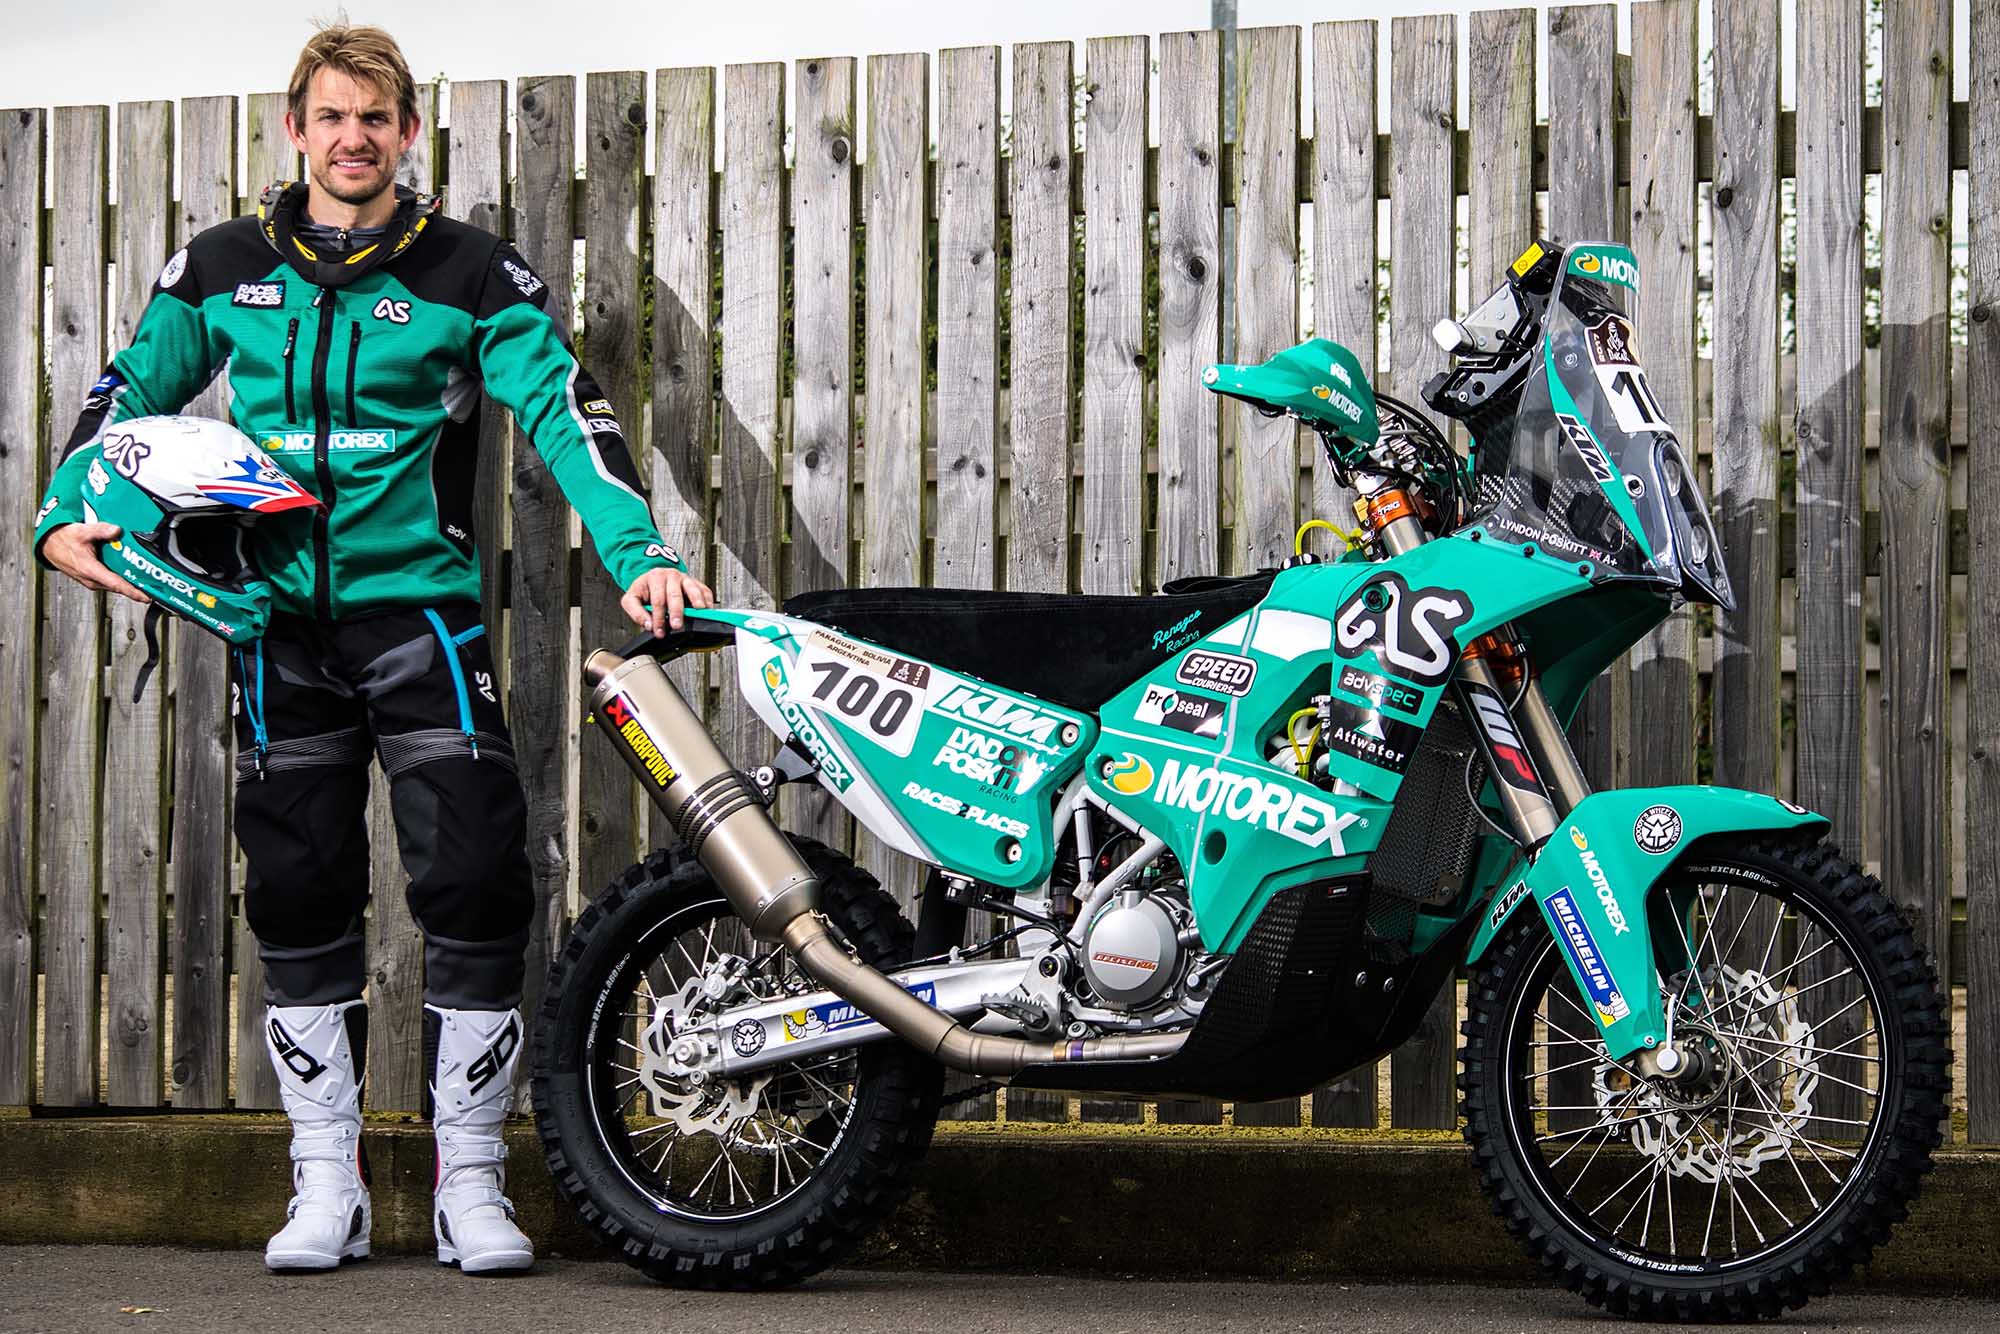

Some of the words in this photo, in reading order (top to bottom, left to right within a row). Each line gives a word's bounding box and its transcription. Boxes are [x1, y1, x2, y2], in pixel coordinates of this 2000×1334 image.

[233, 293, 282, 306] PLACES
[1328, 388, 1363, 424] MOTOREX
[284, 431, 389, 450] MOTOREX
[1499, 518, 1542, 539] LYNDON
[1540, 531, 1588, 556] POSKITT
[1602, 554, 1618, 567] A+
[122, 546, 198, 599] MOTOREX
[815, 629, 858, 652] PARAGUAY
[862, 650, 892, 666] BOLIVIA
[826, 644, 871, 667] ARGENTINA
[1166, 630, 1201, 653] Racing
[1184, 656, 1251, 685] SPEED
[1191, 677, 1235, 696] COURIERS
[810, 661, 914, 737] 100
[938, 686, 1060, 745] KTM
[620, 719, 676, 787] AKRAPOVIC
[772, 682, 850, 788] MOTOREX
[1334, 727, 1405, 763] Attwater
[978, 783, 1018, 805] RACING
[1153, 758, 1362, 858] MOTOREX
[1710, 865, 1742, 877] EXCEL
[1490, 879, 1528, 930] KTM
[1578, 849, 1631, 937] MOTOREX
[1552, 895, 1611, 991] MICHELIN
[592, 988, 610, 1021] EXCEL
[1646, 1259, 1678, 1272] EXCEL
